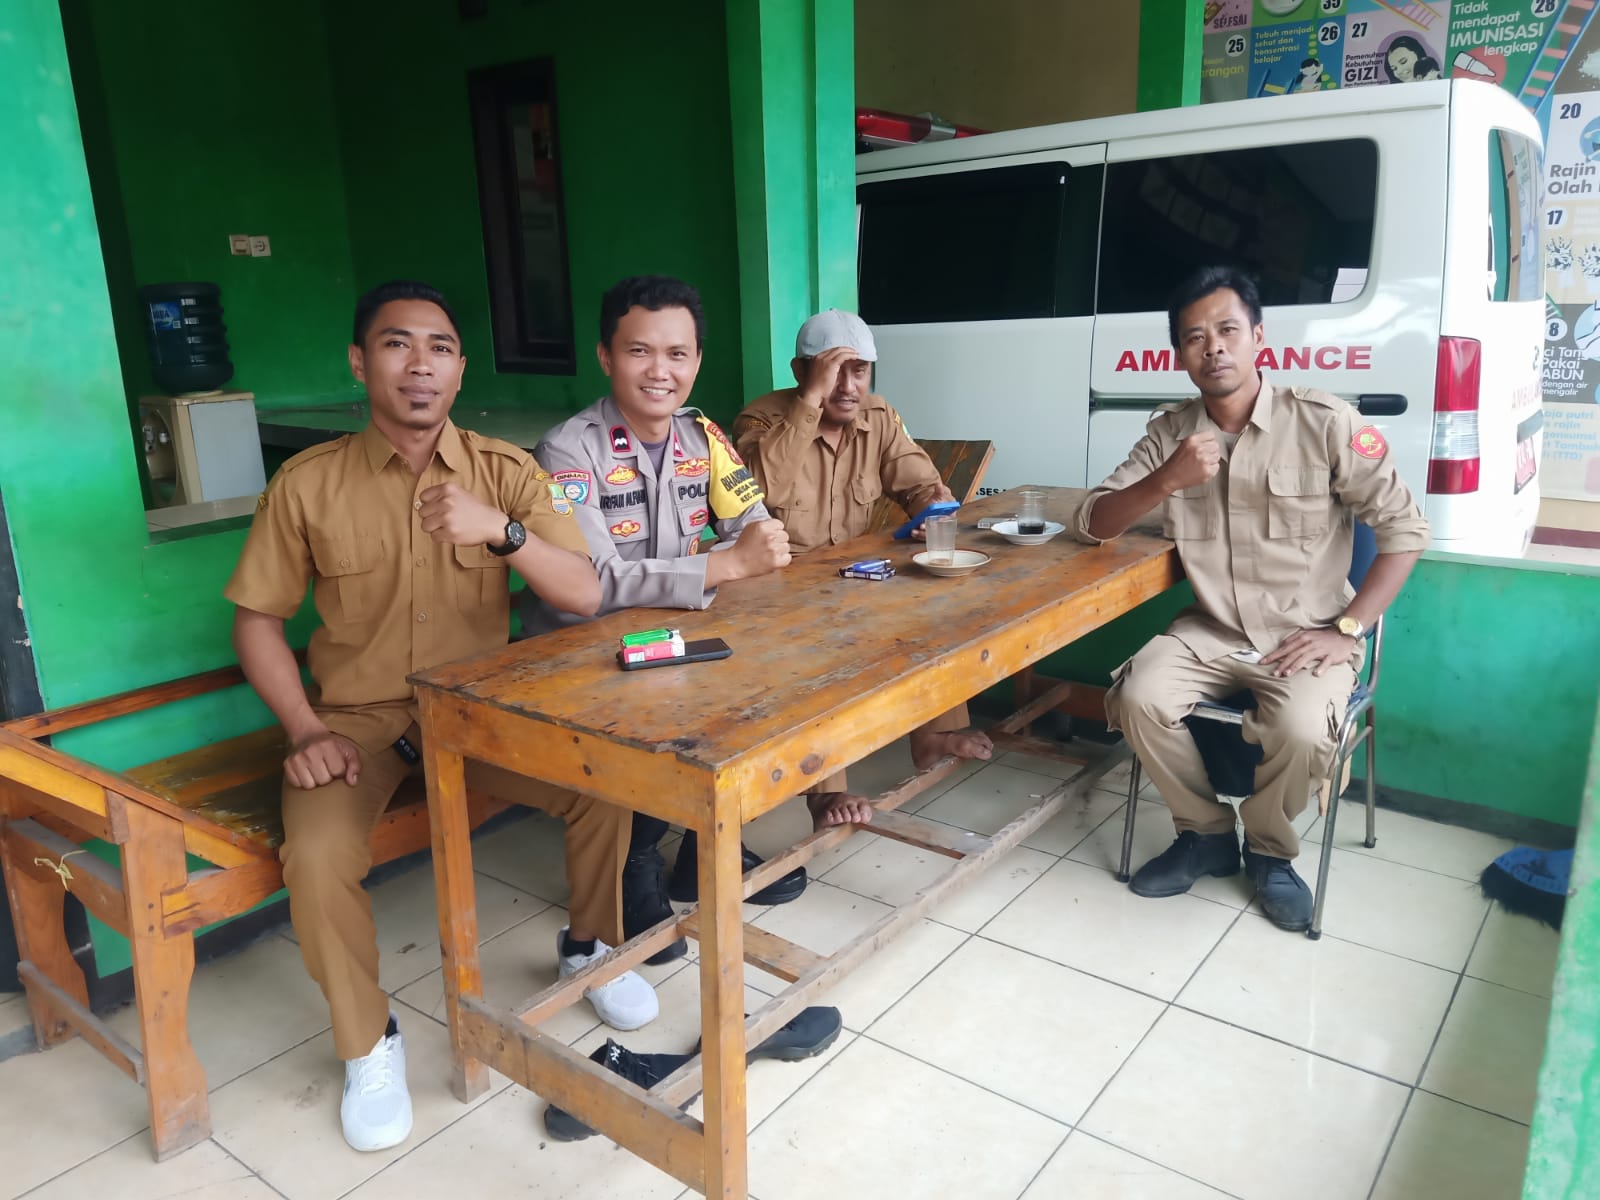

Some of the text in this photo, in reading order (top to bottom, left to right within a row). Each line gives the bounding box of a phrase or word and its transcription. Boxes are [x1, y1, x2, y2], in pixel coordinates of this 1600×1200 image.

[1454, 1, 1488, 15] Tidak
[1534, 0, 1555, 13] 28
[1452, 11, 1520, 30] mendapat
[1255, 31, 1279, 39] Tubuh
[1321, 26, 1338, 41] 26
[1352, 22, 1368, 38] 27
[1450, 22, 1544, 47] IMUNISASI
[1228, 39, 1244, 53] 25
[1484, 41, 1538, 56] lengkap
[1345, 58, 1383, 68] Kebutuhan
[1344, 66, 1379, 82] GIZI
[1559, 102, 1582, 119] 20
[1549, 162, 1596, 180] Rajin
[1547, 180, 1592, 195] Olah
[1546, 210, 1563, 225] 17
[1115, 345, 1372, 371] AMANCE
[1544, 346, 1555, 357] ci
[1542, 368, 1585, 381] ABUN
[1576, 381, 1588, 389] air
